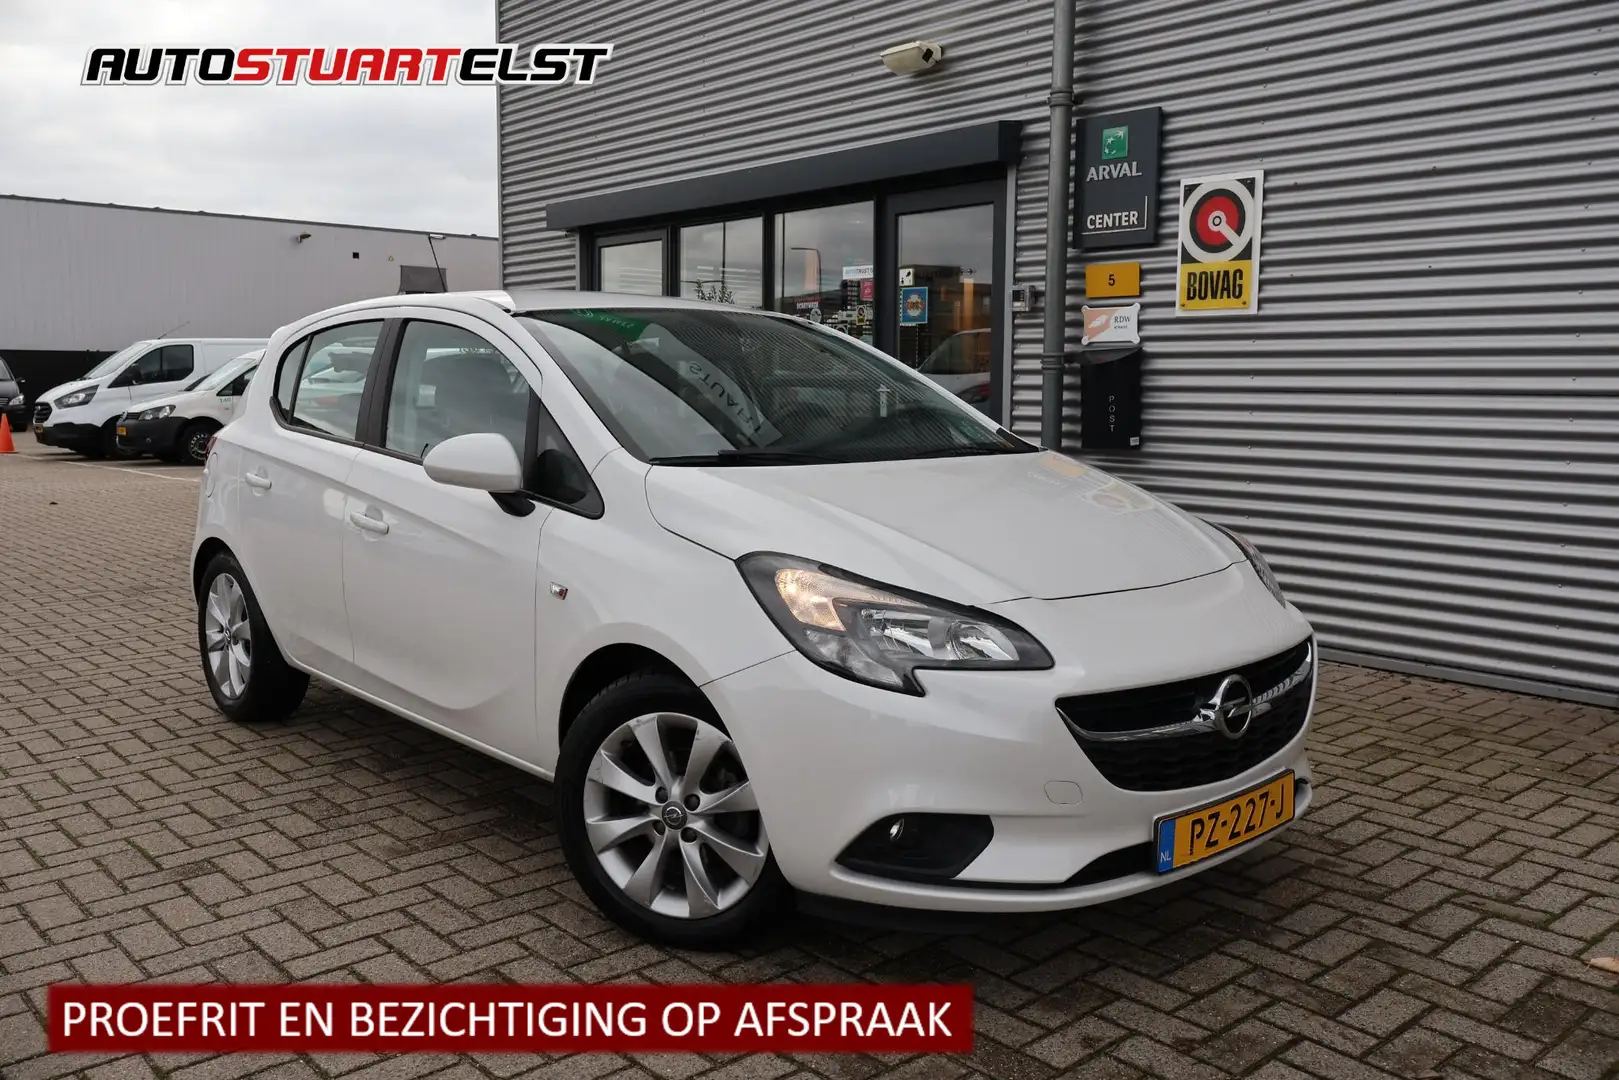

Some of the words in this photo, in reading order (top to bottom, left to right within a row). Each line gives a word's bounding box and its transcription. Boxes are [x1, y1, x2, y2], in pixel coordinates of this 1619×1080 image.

[1086, 161, 1142, 182] ARVAL
[1086, 211, 1138, 230] CENTER
[1108, 274, 1116, 286] 5
[1186, 268, 1244, 301] BOVAG
[1114, 315, 1131, 324] RDW
[1189, 784, 1285, 856] PZ-227-J
[1160, 852, 1171, 863] NL
